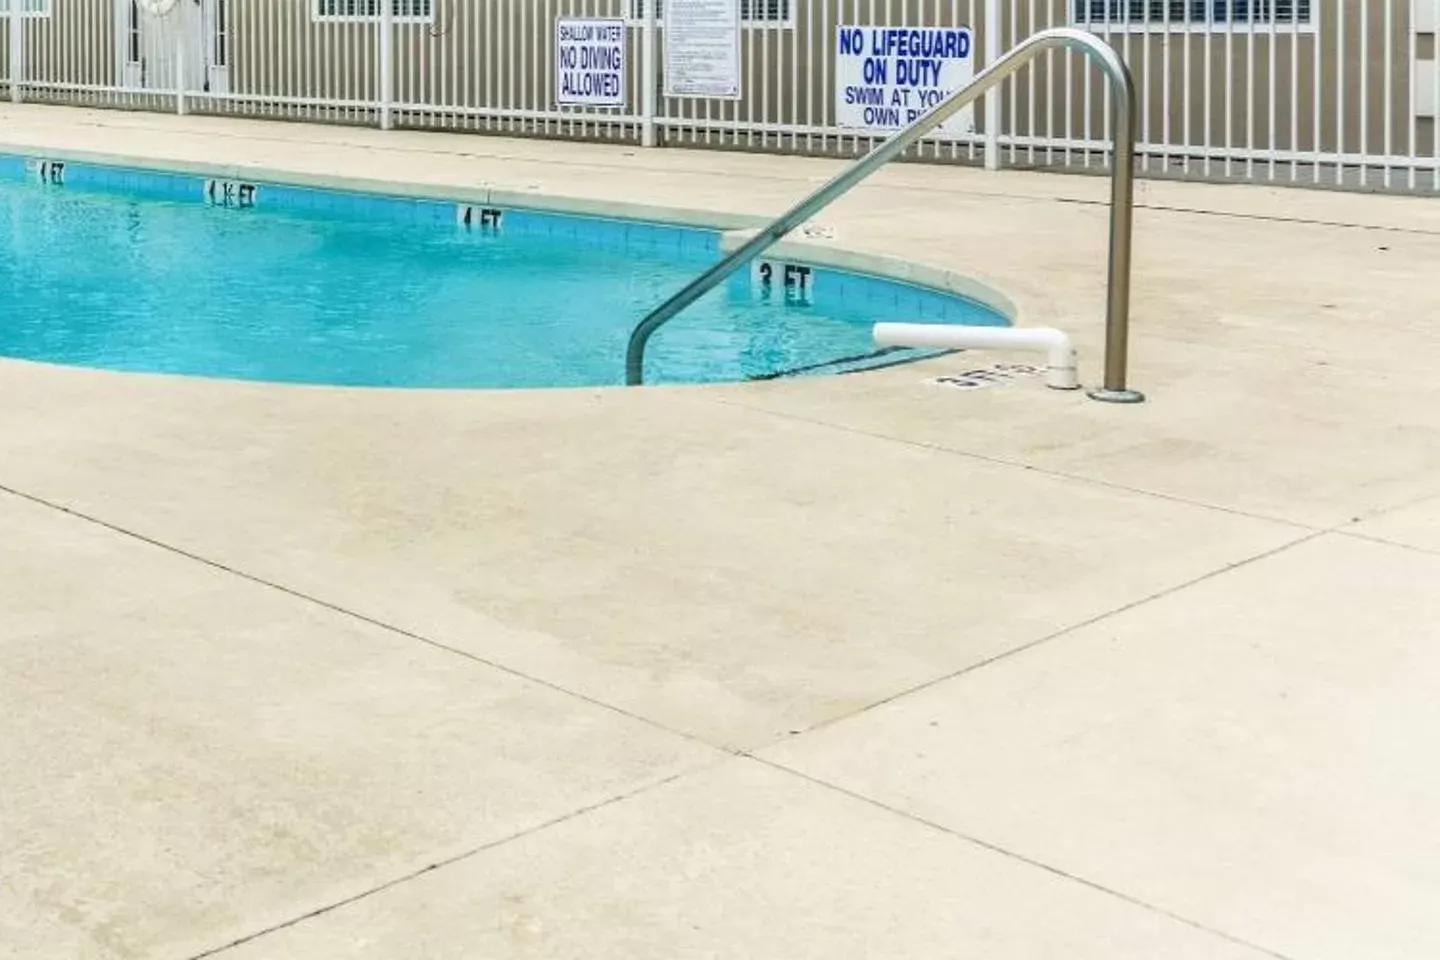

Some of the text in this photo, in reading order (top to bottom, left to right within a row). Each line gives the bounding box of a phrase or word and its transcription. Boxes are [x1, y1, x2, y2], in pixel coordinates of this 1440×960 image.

[839, 29, 971, 59] NO LIFEGUARD
[560, 46, 621, 70] NO DIVING
[863, 57, 942, 87] ON DUTY
[562, 72, 620, 97] ALLOWED
[845, 86, 884, 106] SWIM
[891, 88, 911, 107] AT
[863, 107, 900, 127] OWN
